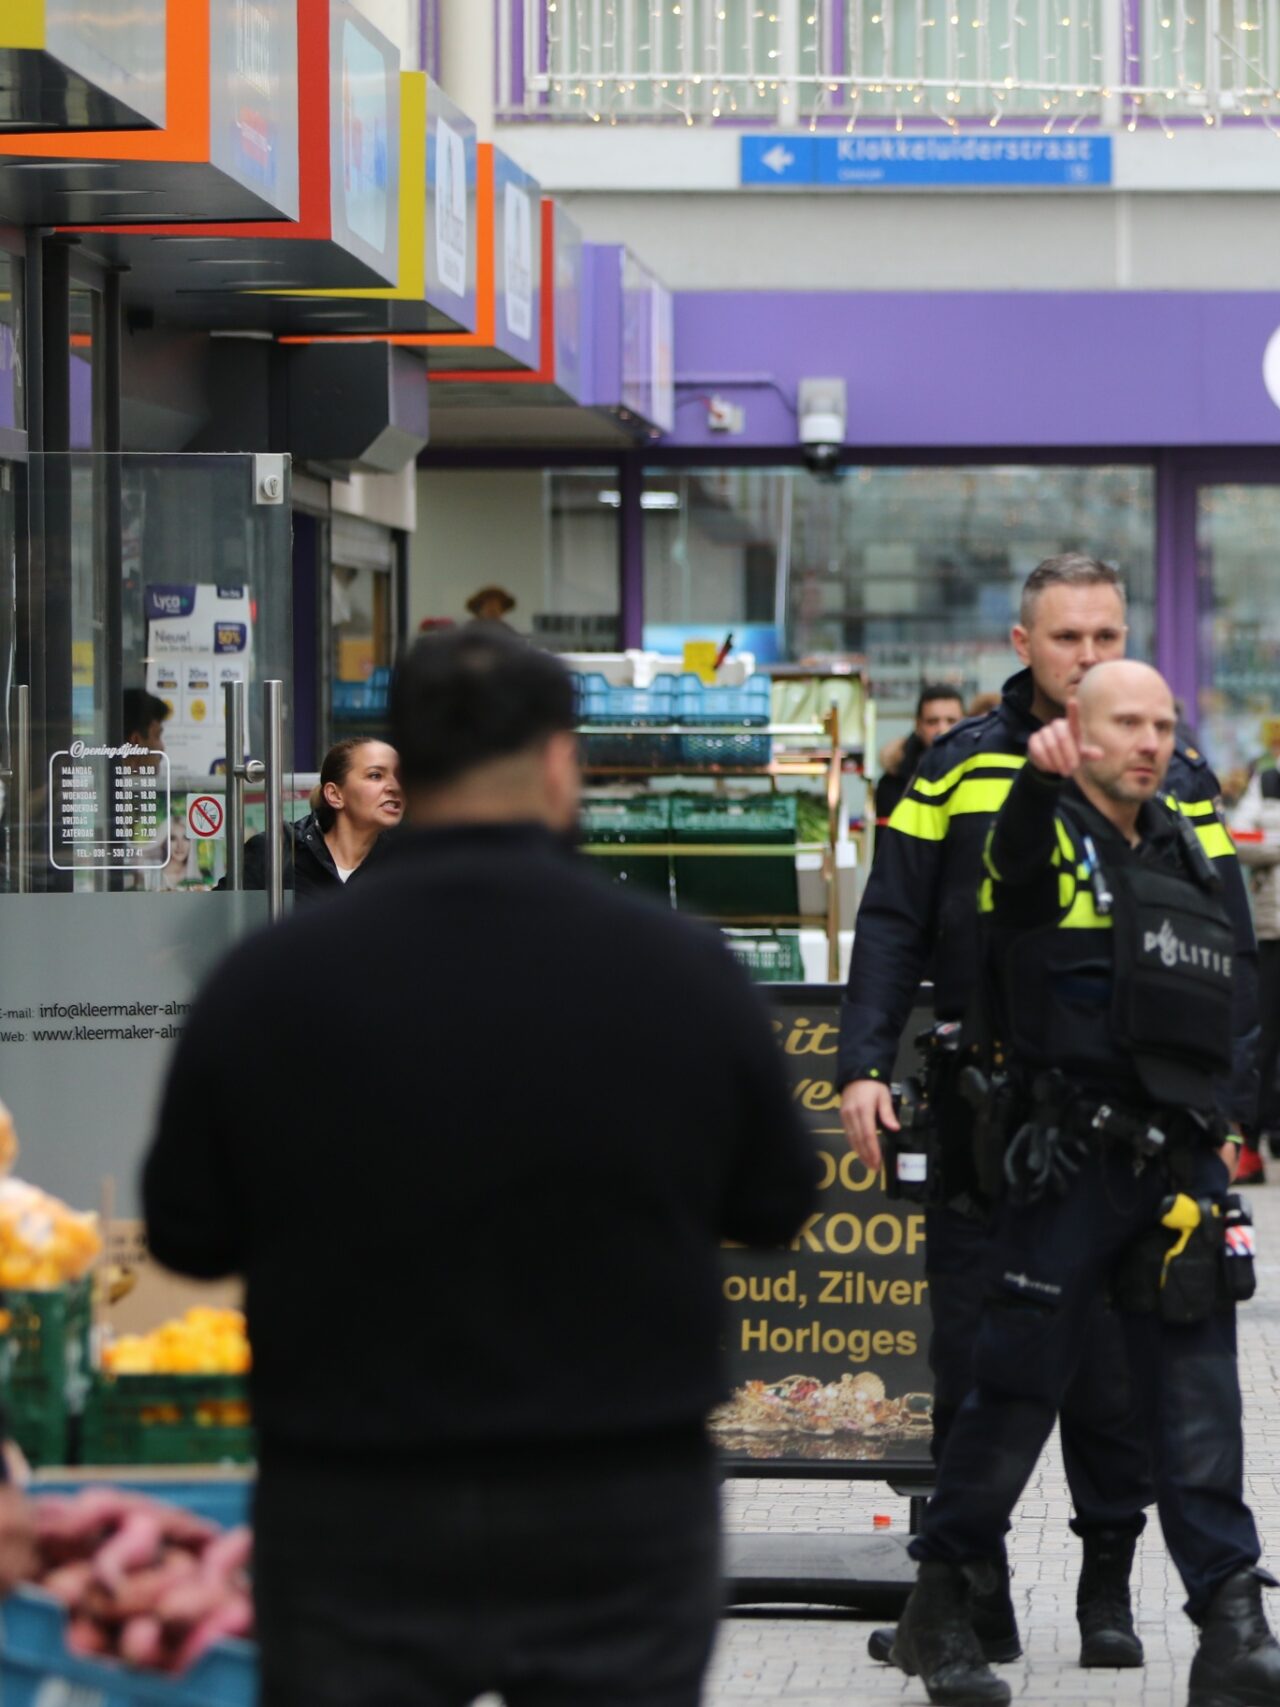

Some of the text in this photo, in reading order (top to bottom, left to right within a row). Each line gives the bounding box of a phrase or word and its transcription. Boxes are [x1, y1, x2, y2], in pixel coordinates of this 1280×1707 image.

[837, 137, 1092, 161] Klokkeluiderstraat
[153, 592, 181, 610] Lyca
[70, 740, 149, 759] Openingstijden
[62, 766, 92, 775] MAANDAG
[62, 779, 88, 788] DINSDAG
[62, 791, 97, 800] WOENSDAG
[62, 803, 98, 813] DONDERDAG
[62, 816, 88, 825] VRIJDAG
[62, 828, 94, 838] ZATERDAG
[1144, 919, 1231, 978] POLITIE
[40, 1001, 192, 1019] info@kleermaker-alm
[722, 1270, 929, 1308] oud, Zilver
[741, 1318, 918, 1363] Horloges
